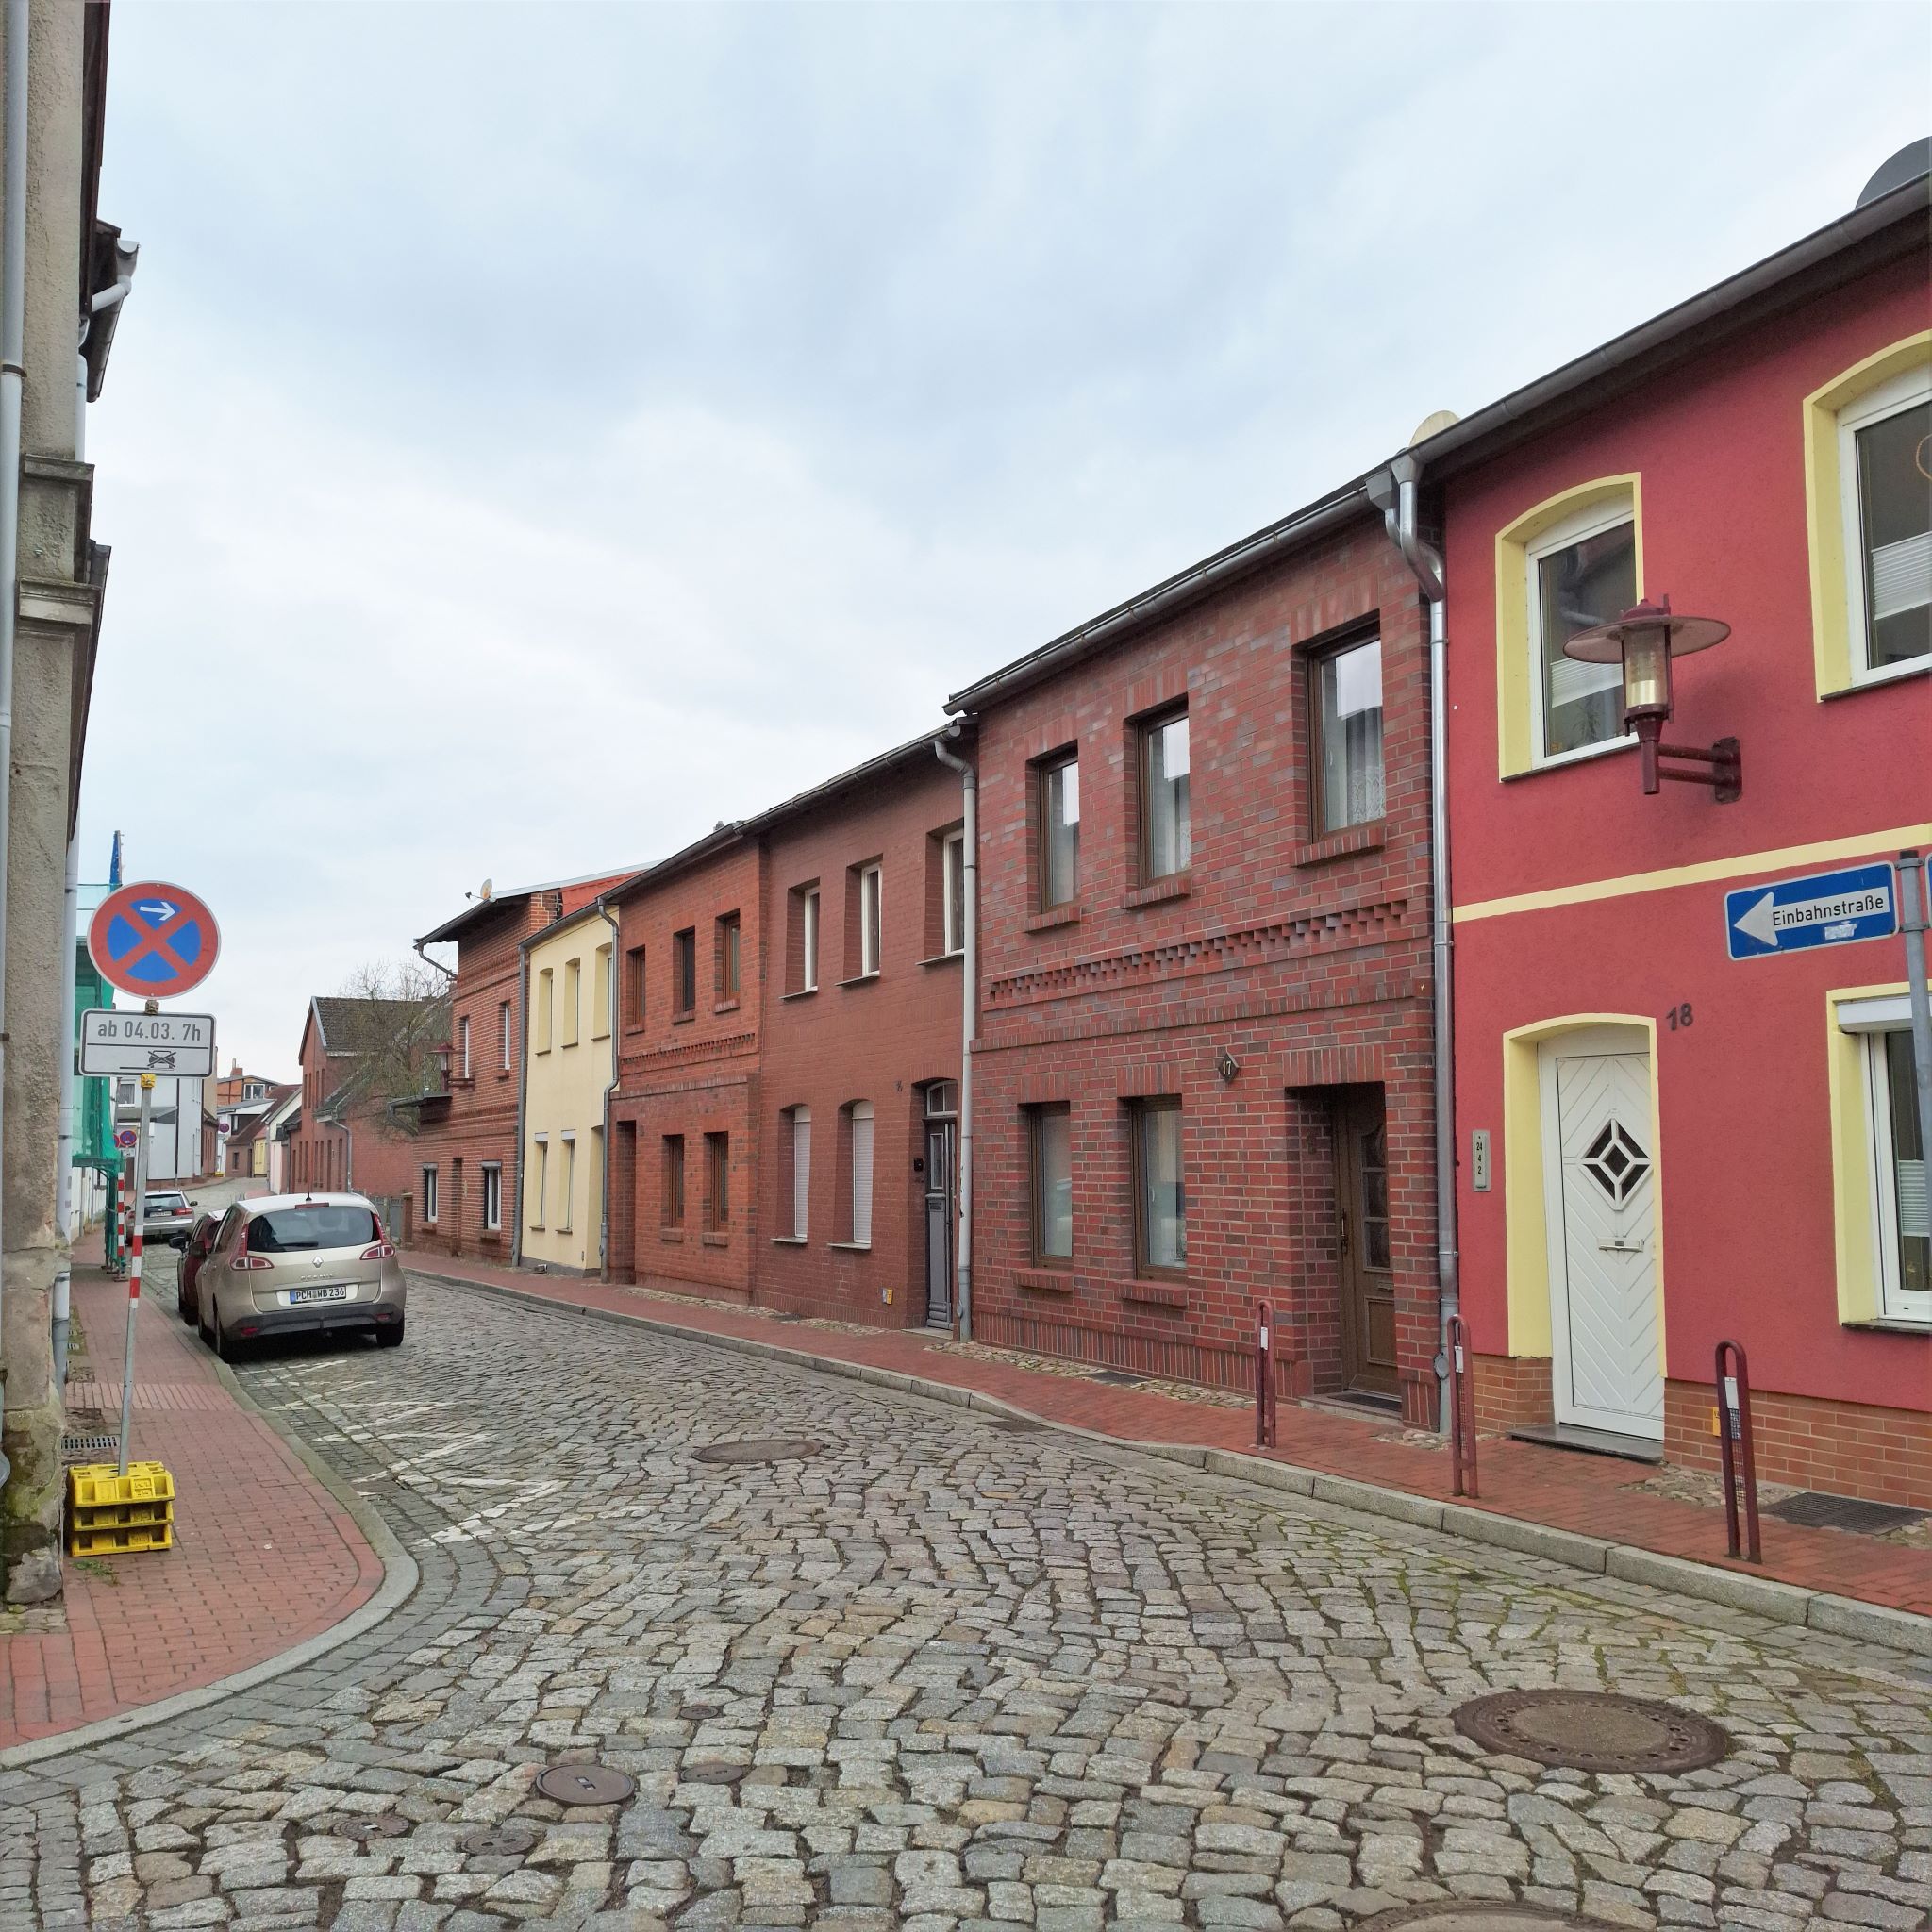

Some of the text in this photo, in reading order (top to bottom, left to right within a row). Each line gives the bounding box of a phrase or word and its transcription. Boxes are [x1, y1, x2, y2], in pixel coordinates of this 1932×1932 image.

[1772, 894, 1885, 926] Einbahnstraße
[1665, 1003, 1694, 1031] 18
[97, 1020, 201, 1041] ab 04.03. 7h
[1223, 1060, 1232, 1076] 17
[295, 1287, 345, 1301] PCH WB 236
